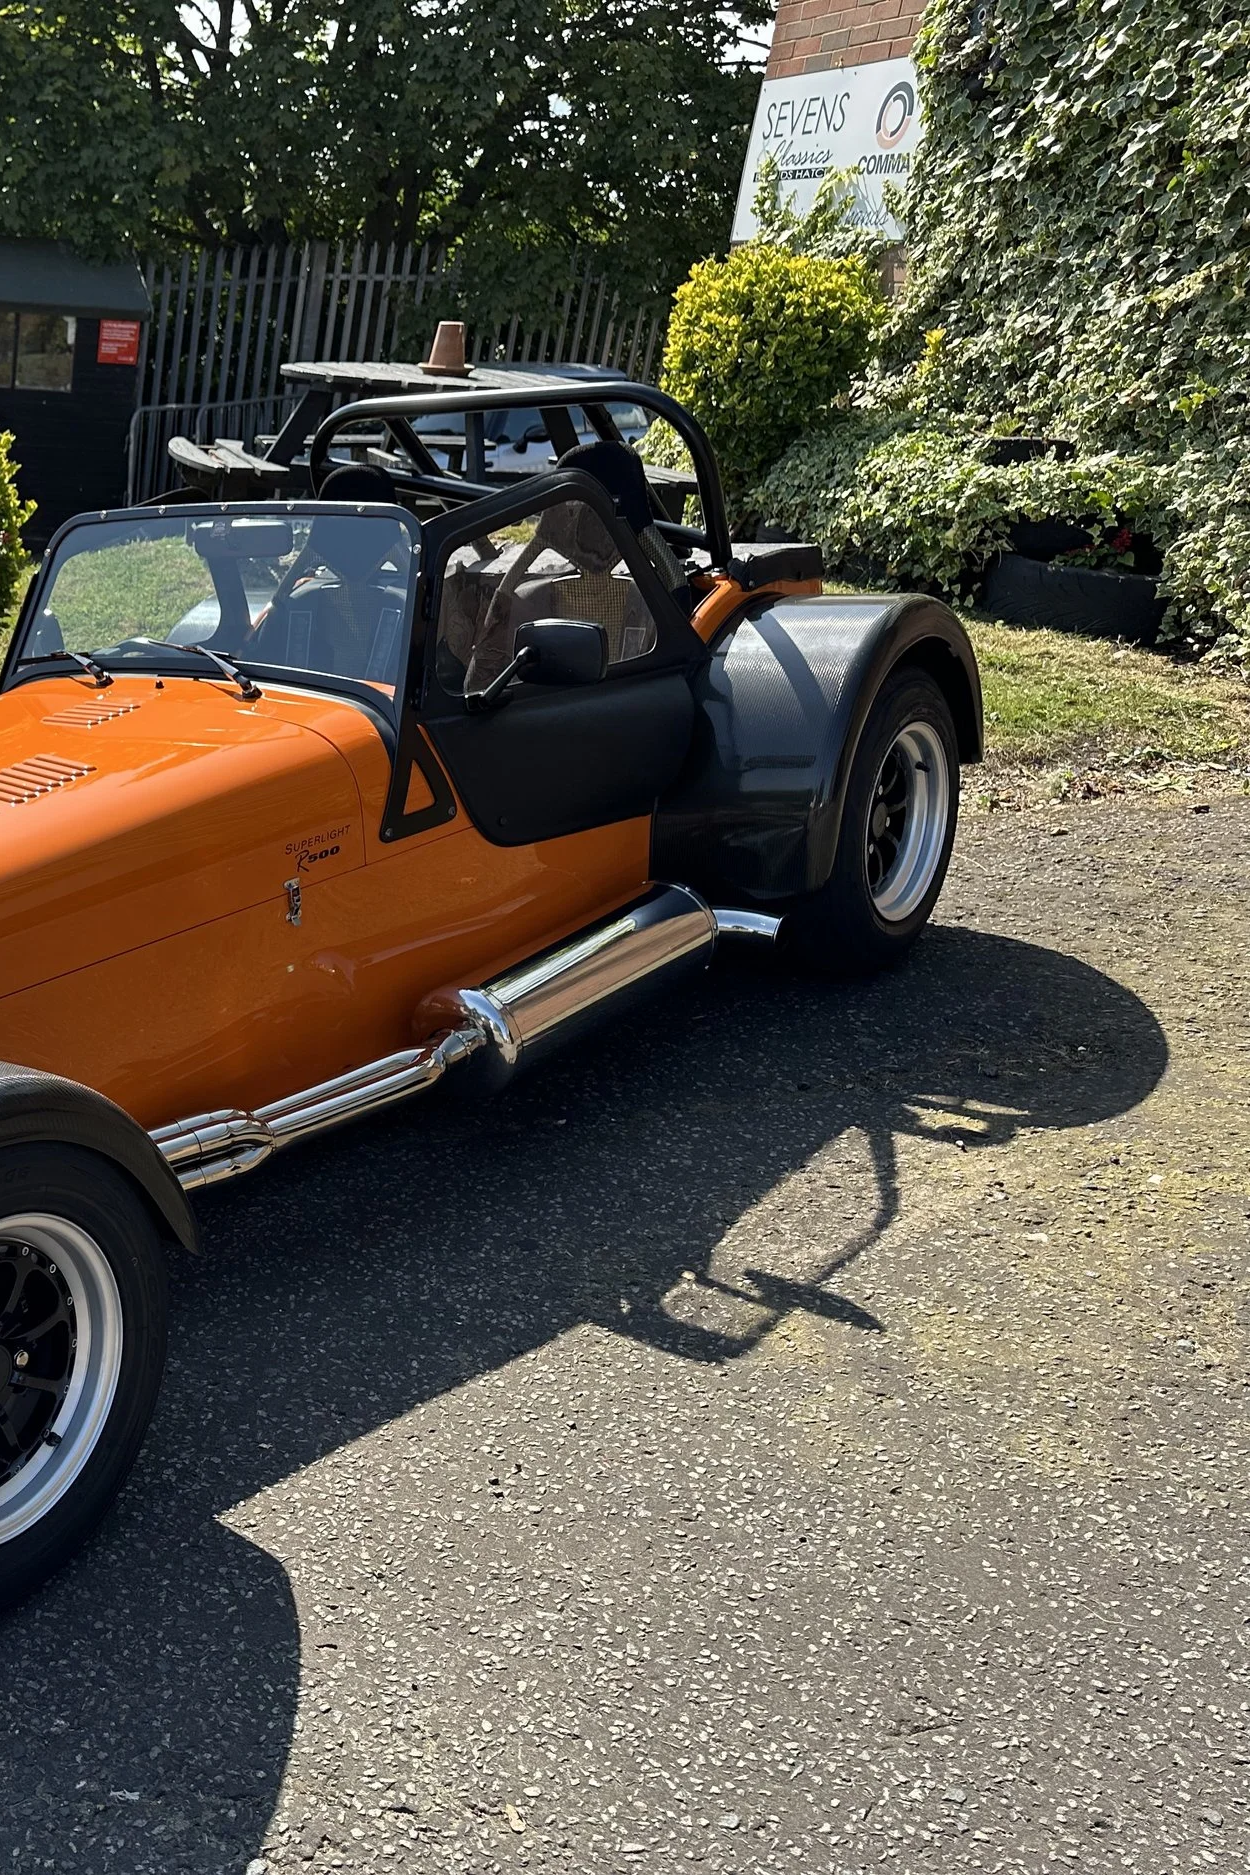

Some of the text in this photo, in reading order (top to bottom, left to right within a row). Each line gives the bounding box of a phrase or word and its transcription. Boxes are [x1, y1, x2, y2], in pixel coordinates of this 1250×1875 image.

[762, 92, 850, 140] SEVENS
[794, 168, 828, 180] HATC
[857, 152, 911, 176] COMMA
[285, 824, 351, 855] SUPERLIGHT
[294, 845, 341, 873] R500
